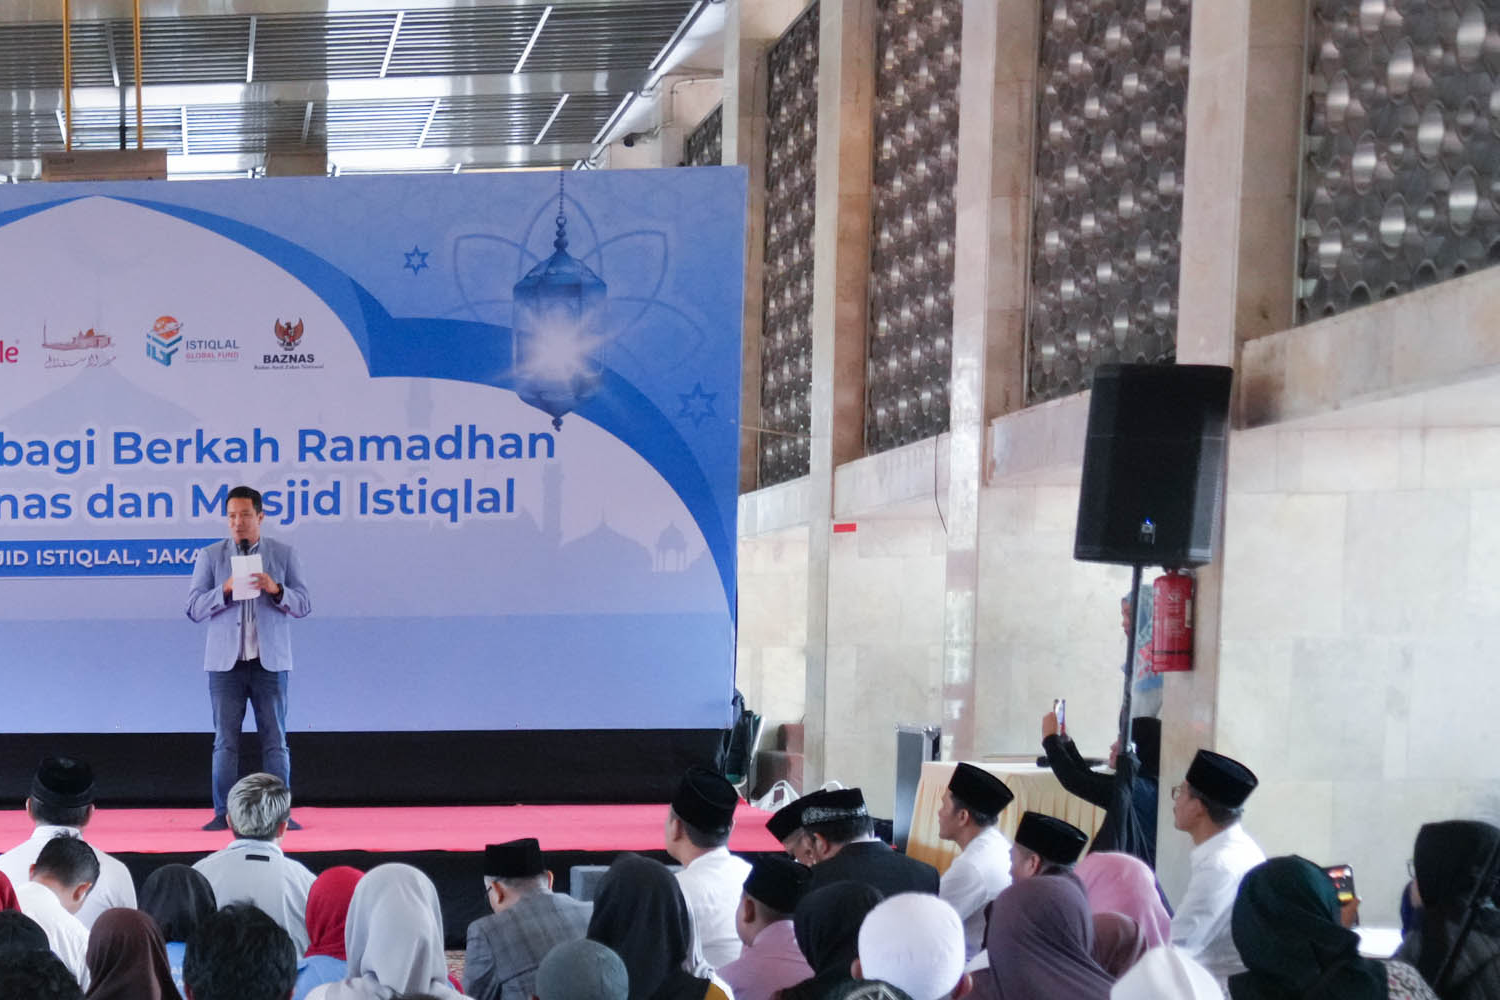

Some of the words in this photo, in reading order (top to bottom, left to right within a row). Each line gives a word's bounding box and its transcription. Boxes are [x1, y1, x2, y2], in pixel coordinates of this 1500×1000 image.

[186, 339, 239, 350] ISTIQLAL
[263, 353, 315, 364] BAZNAS
[112, 427, 280, 465] Berkah
[297, 424, 556, 463] Ramadhan
[86, 483, 174, 519] dan
[191, 478, 341, 526] Msjid
[360, 476, 515, 524] Istiqlal
[36, 547, 141, 569] ISTIQLAL,
